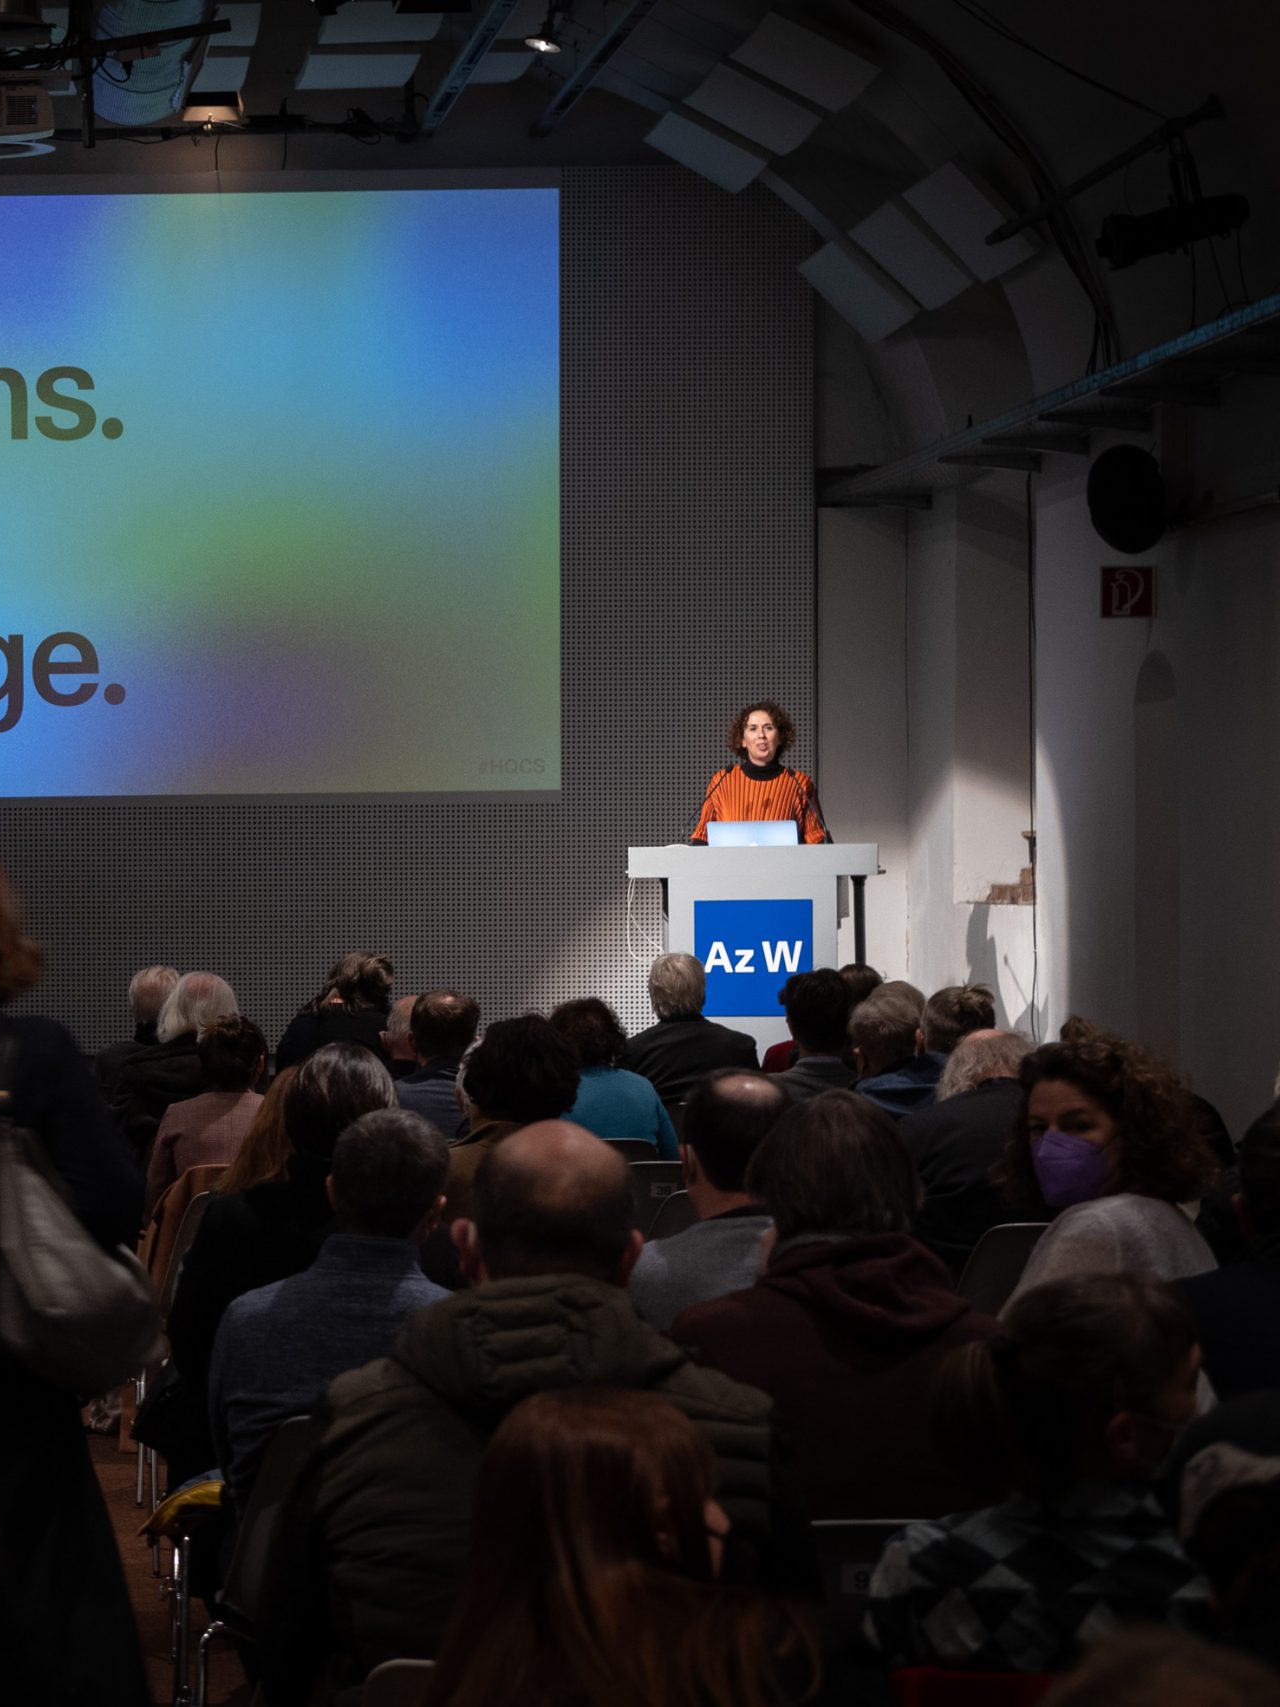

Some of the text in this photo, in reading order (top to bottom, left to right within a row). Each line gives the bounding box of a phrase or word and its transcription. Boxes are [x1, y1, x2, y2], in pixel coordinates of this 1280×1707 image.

[479, 758, 546, 774] #HQCS
[704, 941, 803, 973] Az W
[656, 1186, 672, 1196] 38
